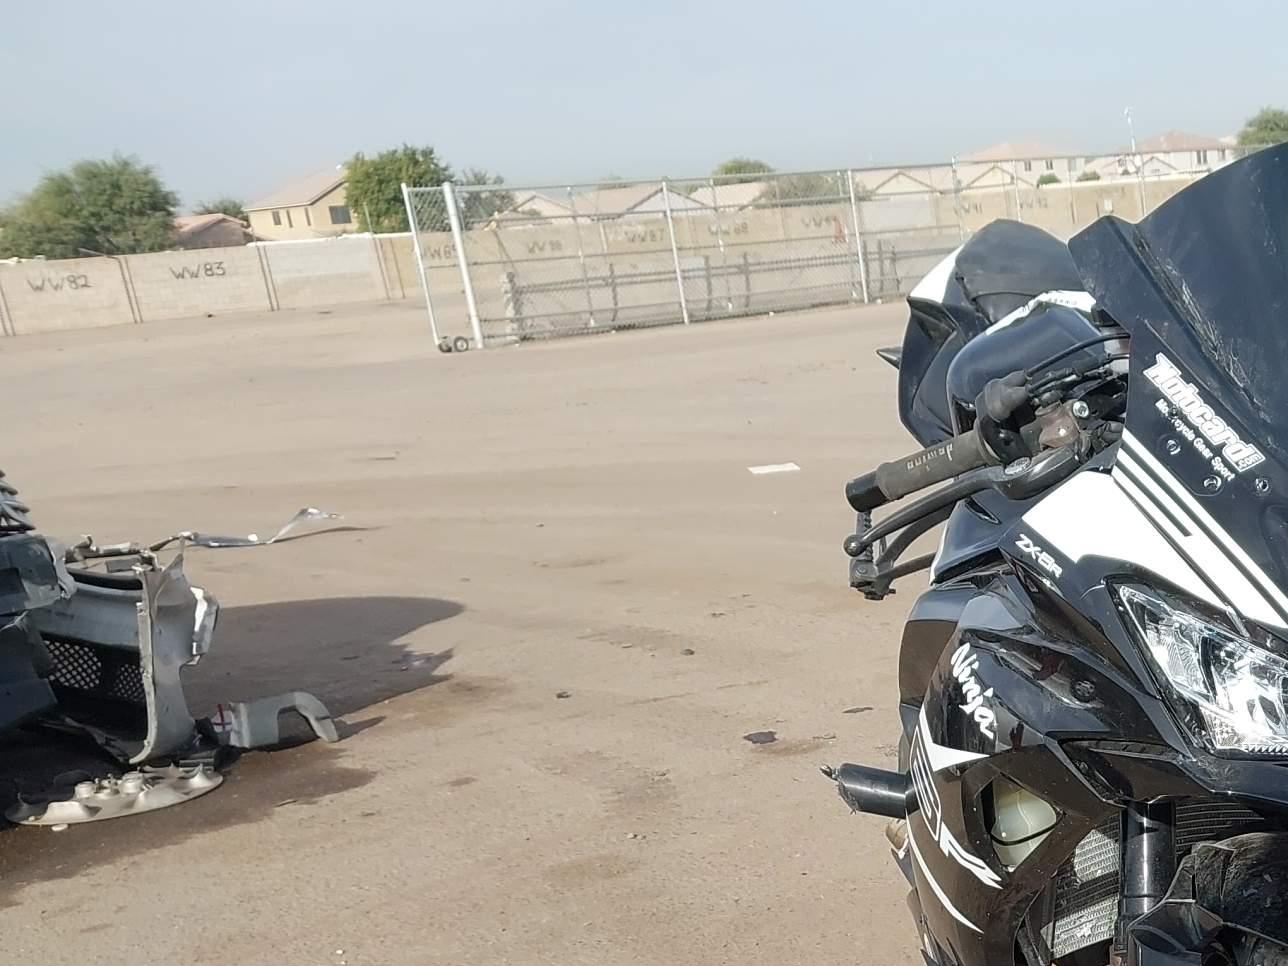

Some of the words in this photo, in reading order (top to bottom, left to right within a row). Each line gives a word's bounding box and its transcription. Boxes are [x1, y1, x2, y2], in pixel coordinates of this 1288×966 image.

[1193, 438, 1214, 460] Gear
[1211, 456, 1235, 482] Sport
[950, 642, 998, 740] Ninja
